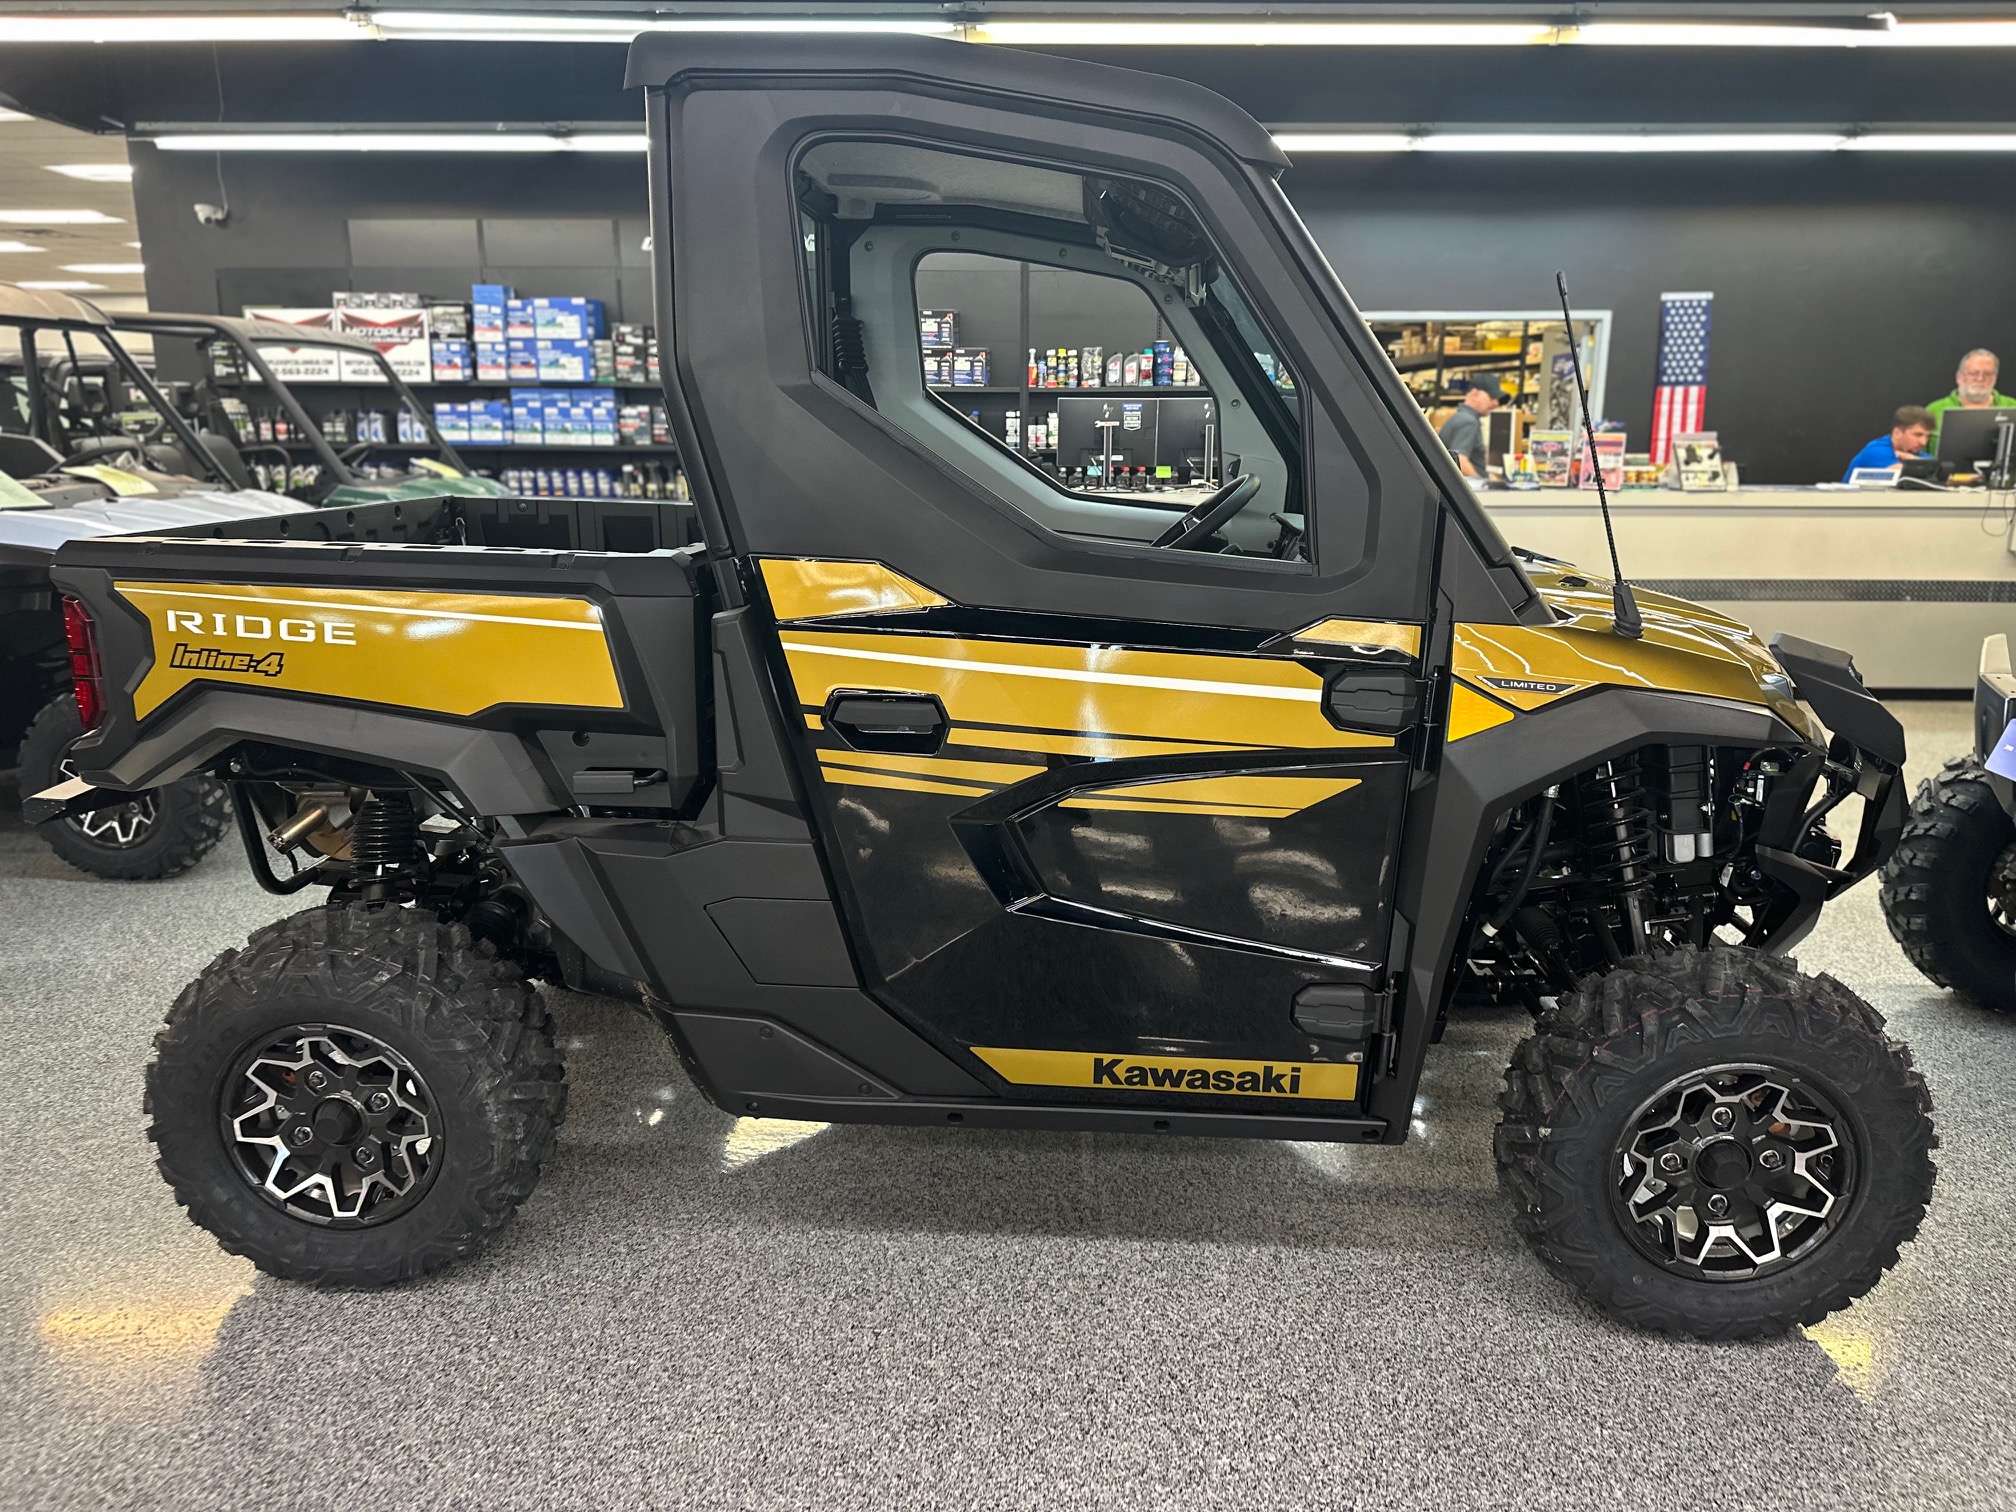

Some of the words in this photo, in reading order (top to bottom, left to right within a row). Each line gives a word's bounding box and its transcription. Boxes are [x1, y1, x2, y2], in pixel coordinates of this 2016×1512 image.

[345, 326, 422, 338] MOTOPLEX
[166, 609, 357, 646] RIDGE
[169, 642, 285, 677] Inline-4
[1500, 680, 1557, 692] LIMITED
[1092, 1057, 1302, 1095] Kawasaki
